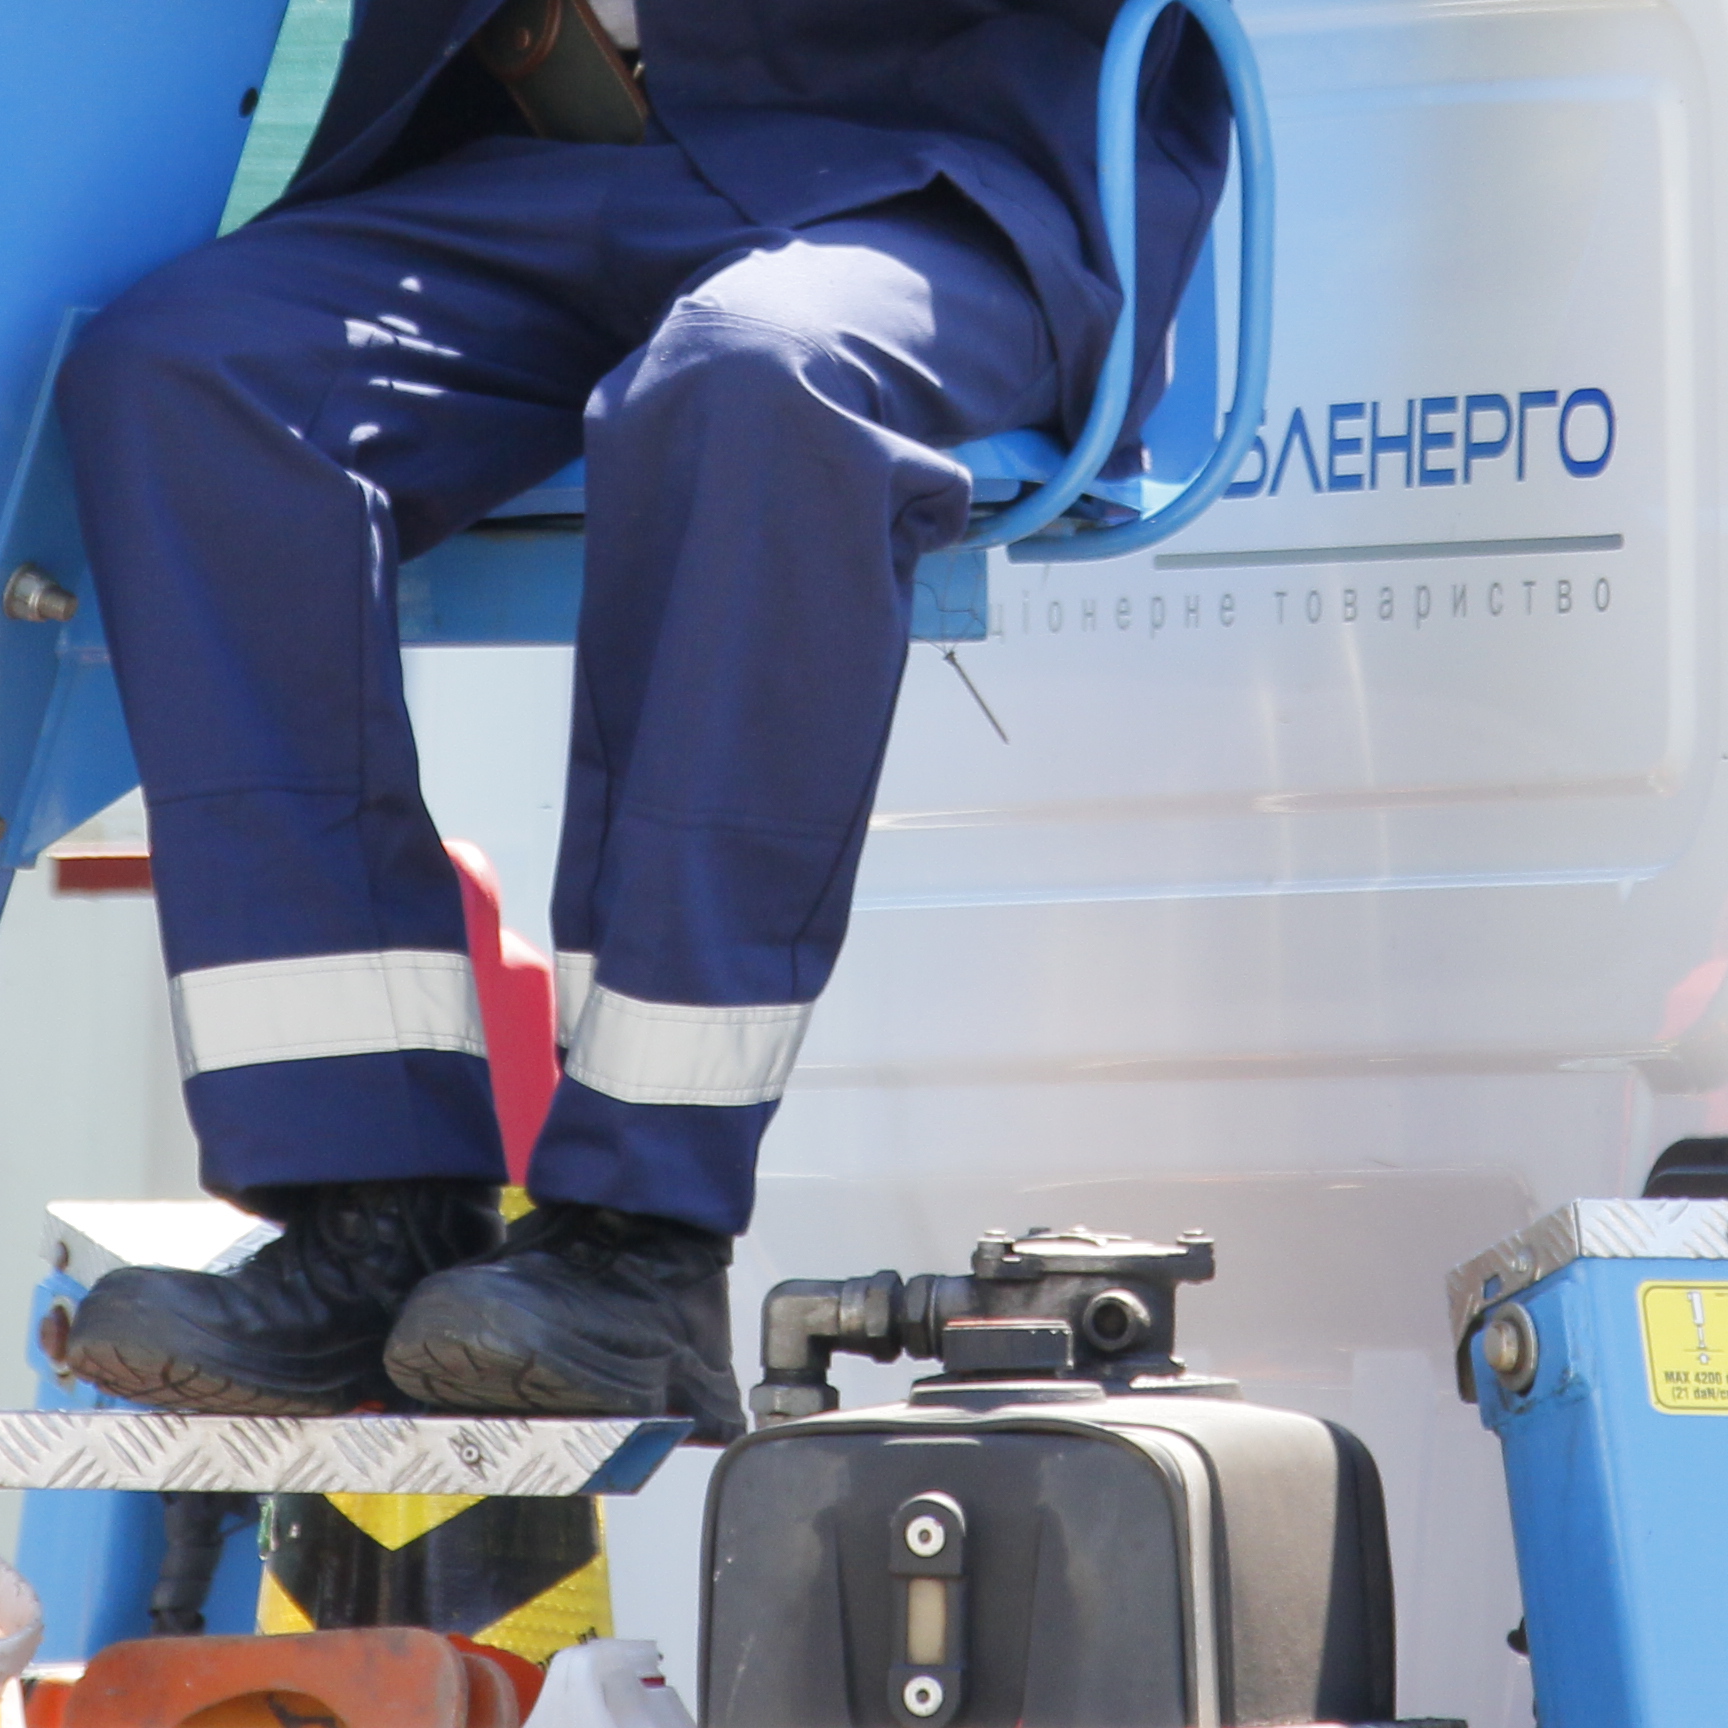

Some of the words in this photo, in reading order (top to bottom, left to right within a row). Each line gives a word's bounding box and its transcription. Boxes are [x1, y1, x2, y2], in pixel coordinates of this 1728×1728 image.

[1274, 576, 1613, 630] товариство
[1664, 1370, 1690, 1385] MAX
[1694, 1371, 1722, 1385] 4200
